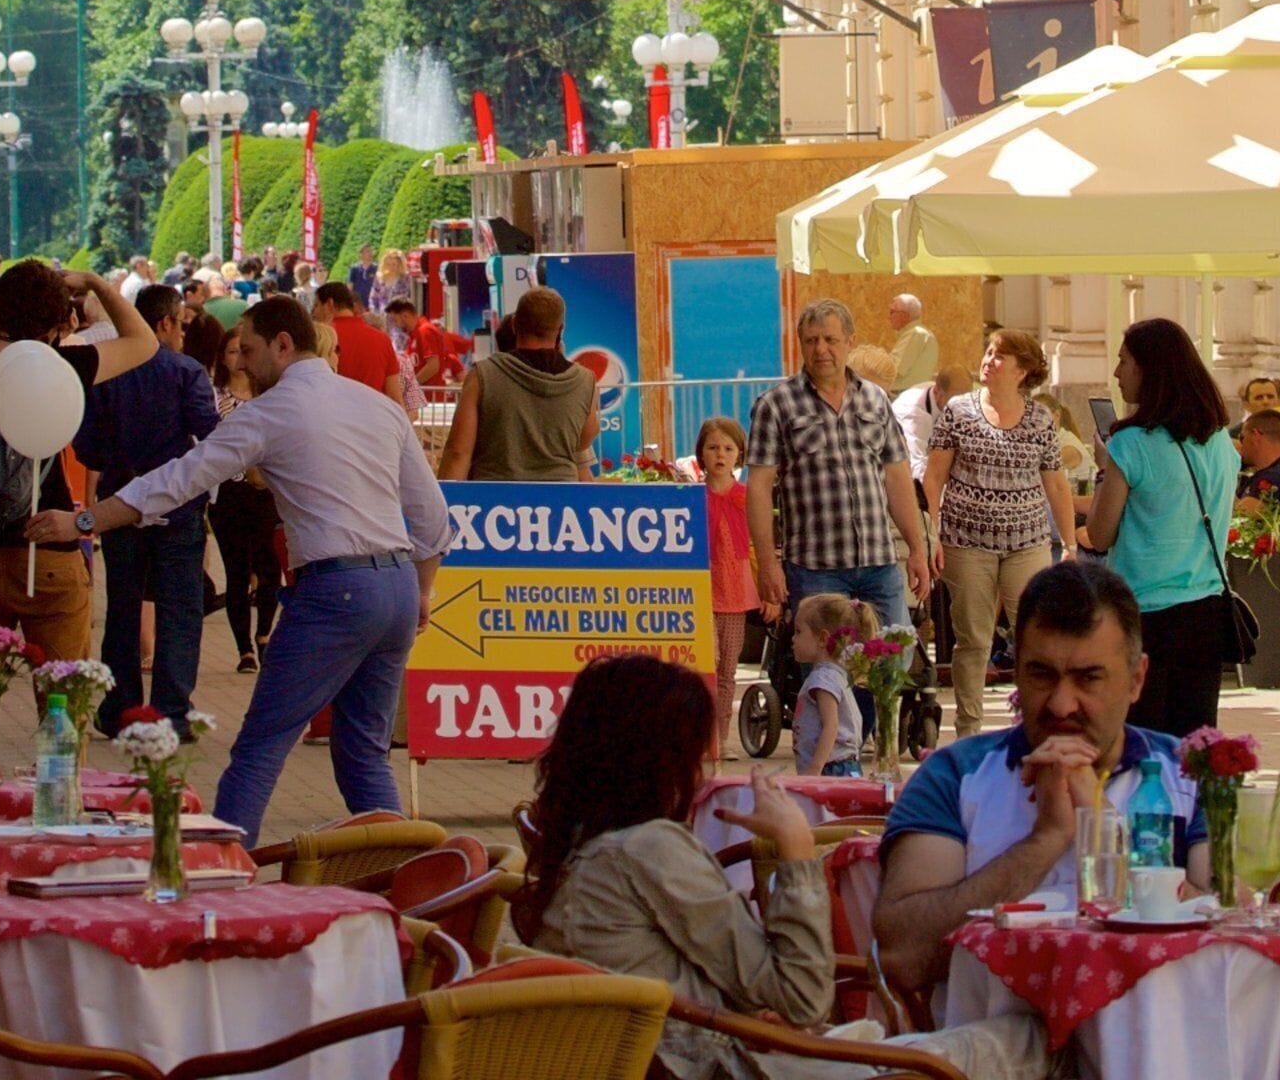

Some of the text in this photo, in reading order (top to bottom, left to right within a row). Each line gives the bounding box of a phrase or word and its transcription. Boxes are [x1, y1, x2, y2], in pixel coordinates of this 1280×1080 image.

[448, 505, 693, 553] XCHANGE
[505, 585, 694, 605] NEGOCIEM SI OFERIM
[478, 608, 695, 634] CEL MAI BUN CURS
[426, 683, 572, 739] TAB
